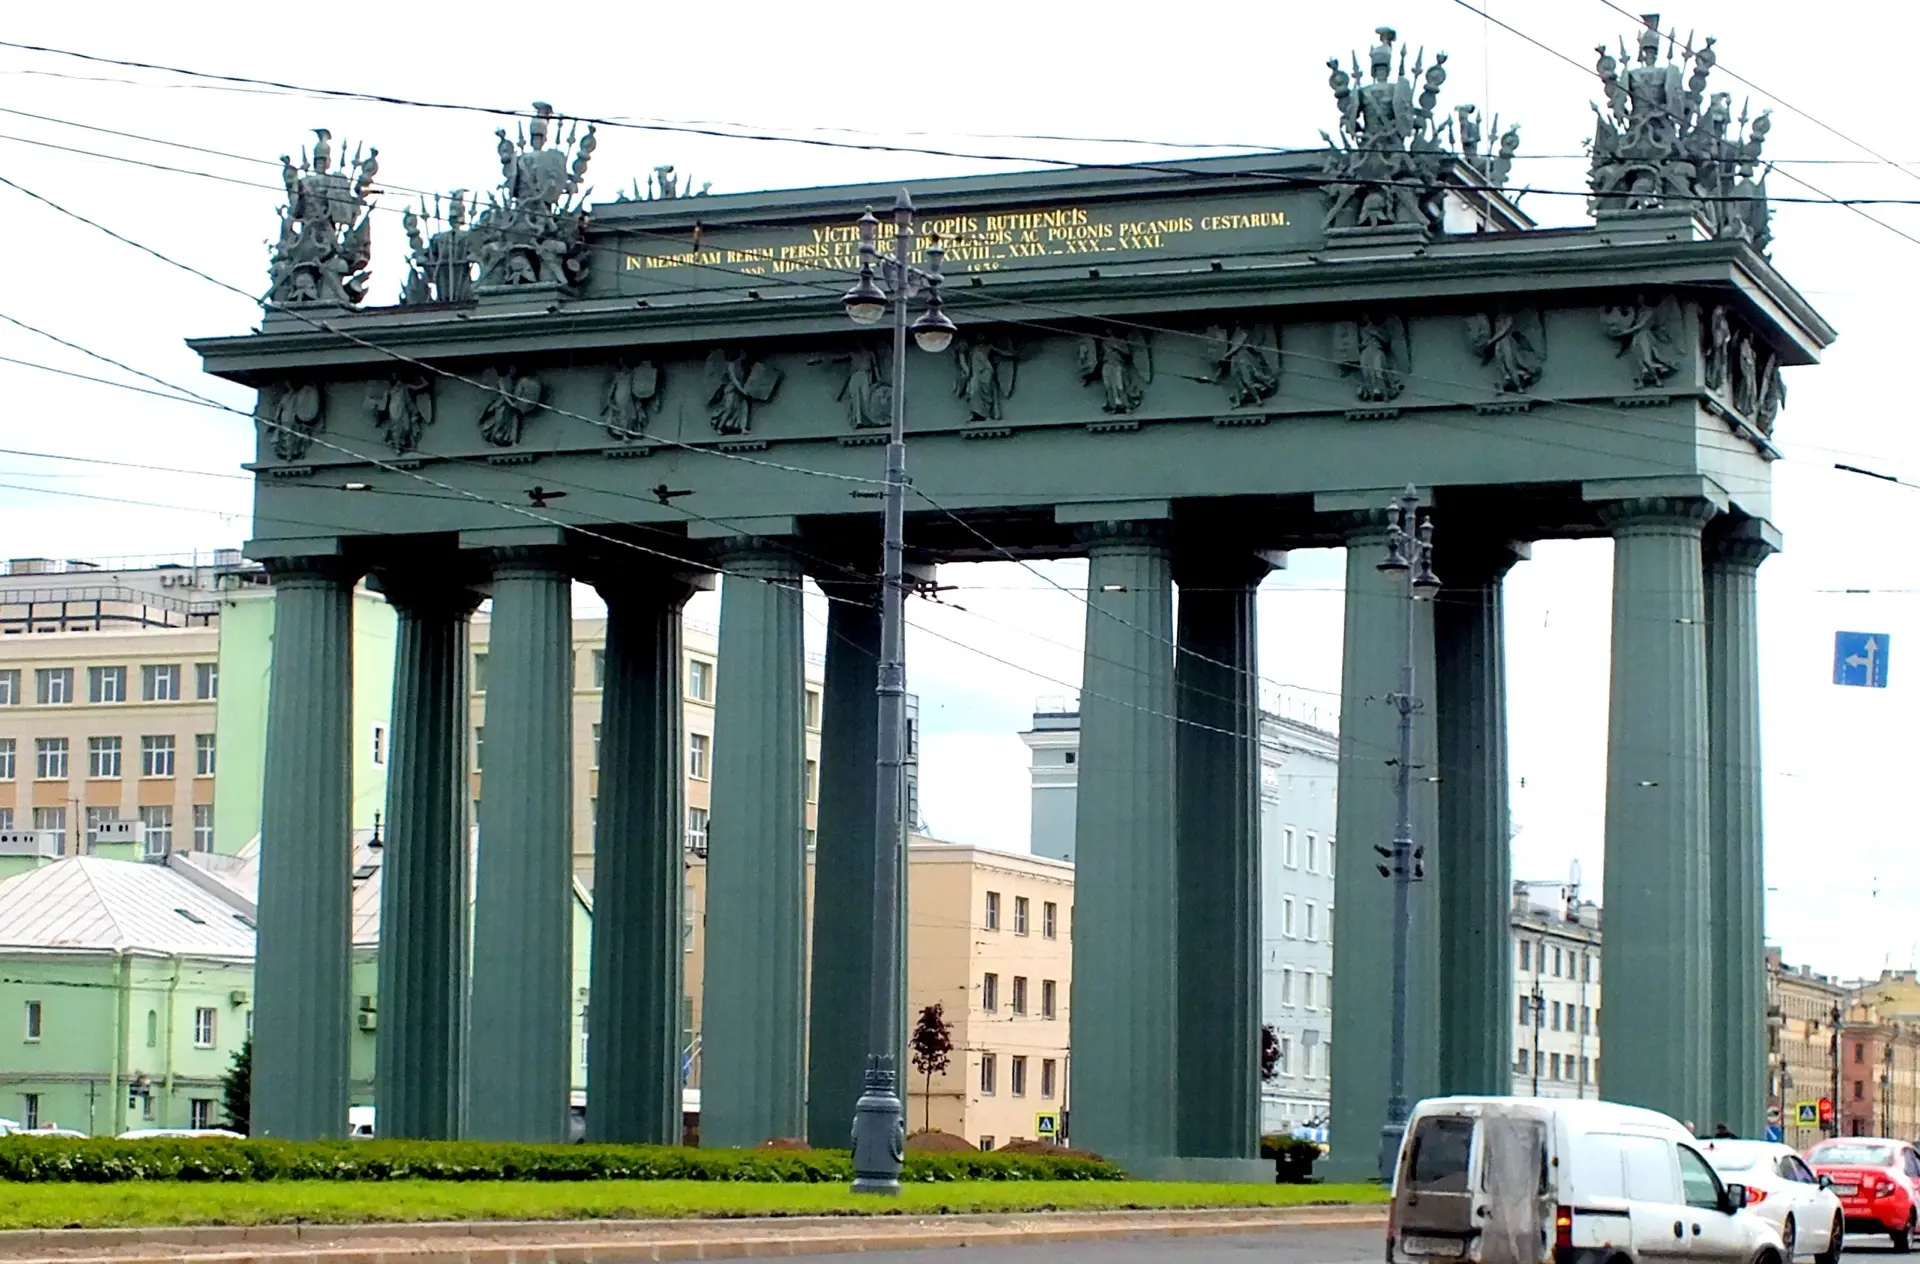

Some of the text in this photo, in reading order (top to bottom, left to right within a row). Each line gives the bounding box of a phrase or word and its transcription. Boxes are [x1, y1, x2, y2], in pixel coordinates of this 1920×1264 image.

[626, 255, 641, 270] IN
[727, 247, 774, 264] RERUM
[781, 242, 829, 260] PERSIS
[834, 242, 853, 256] ET
[1020, 229, 1040, 243] AC
[1047, 223, 1113, 241] POLONIS
[1119, 217, 1194, 237] PACANDIS
[812, 207, 1088, 243] VICTRIBS COPIIS RUTHENICIS
